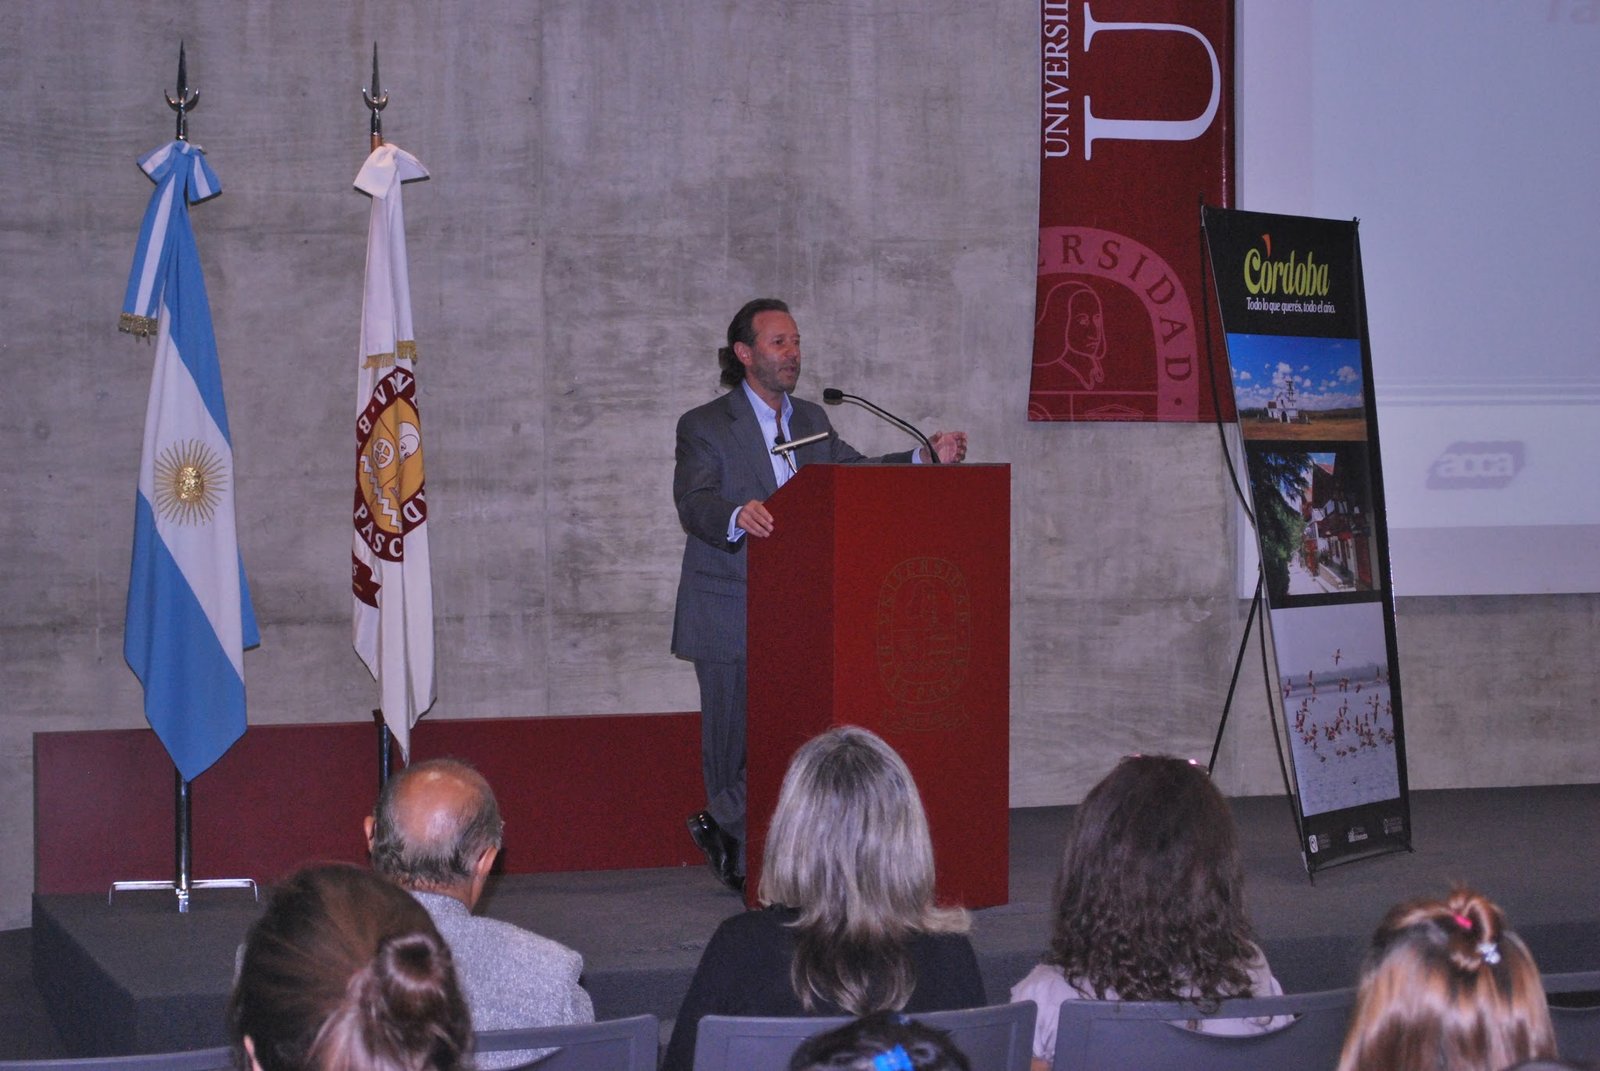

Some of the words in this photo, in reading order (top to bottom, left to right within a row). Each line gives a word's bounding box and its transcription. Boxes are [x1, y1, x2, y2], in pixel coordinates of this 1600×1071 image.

[1084, 2, 1221, 160] U
[1037, 234, 1192, 382] RSIDAD
[1246, 296, 1262, 310] Todo
[1269, 301, 1281, 315] que
[1303, 299, 1317, 313] todo
[1317, 300, 1323, 313] el
